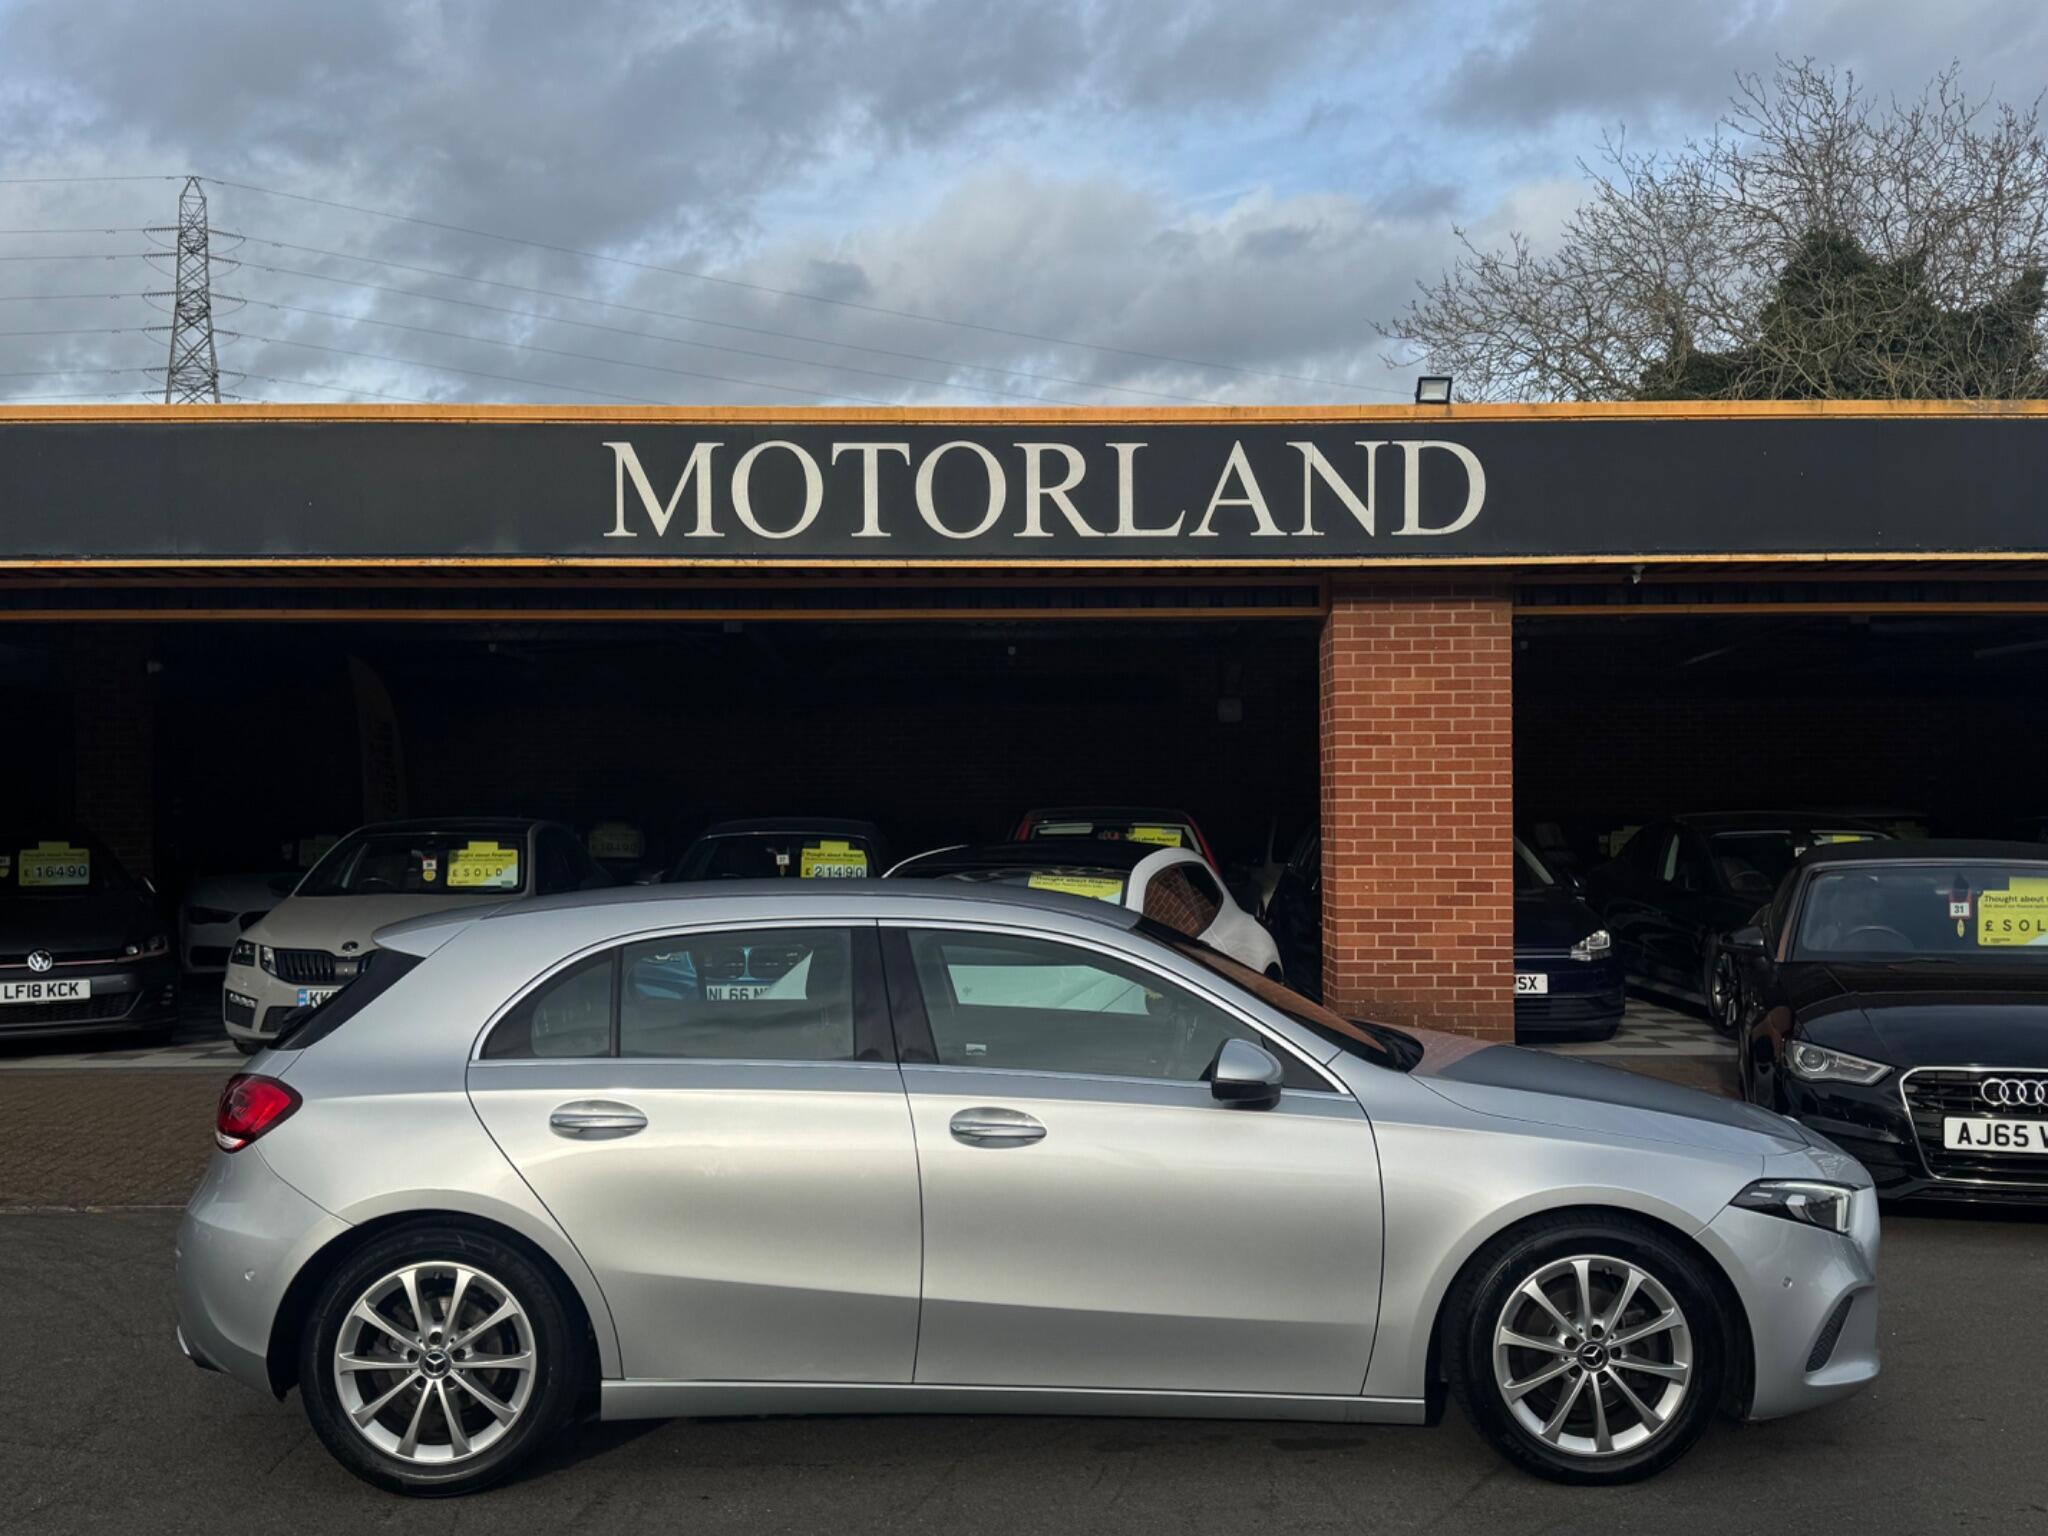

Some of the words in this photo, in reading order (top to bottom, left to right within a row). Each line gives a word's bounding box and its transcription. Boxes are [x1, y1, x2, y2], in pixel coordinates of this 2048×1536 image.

[603, 440, 1486, 539] MOTORLAND
[36, 864, 88, 878] 16490
[463, 867, 503, 878] SOLD
[815, 865, 864, 878] 21490
[1984, 895, 2018, 904] Thought
[2020, 895, 2044, 903] about
[1953, 904, 1965, 914] 31
[4, 983, 42, 1000] LF18
[46, 981, 80, 998] KCK
[1957, 1121, 2030, 1148] AJ65
